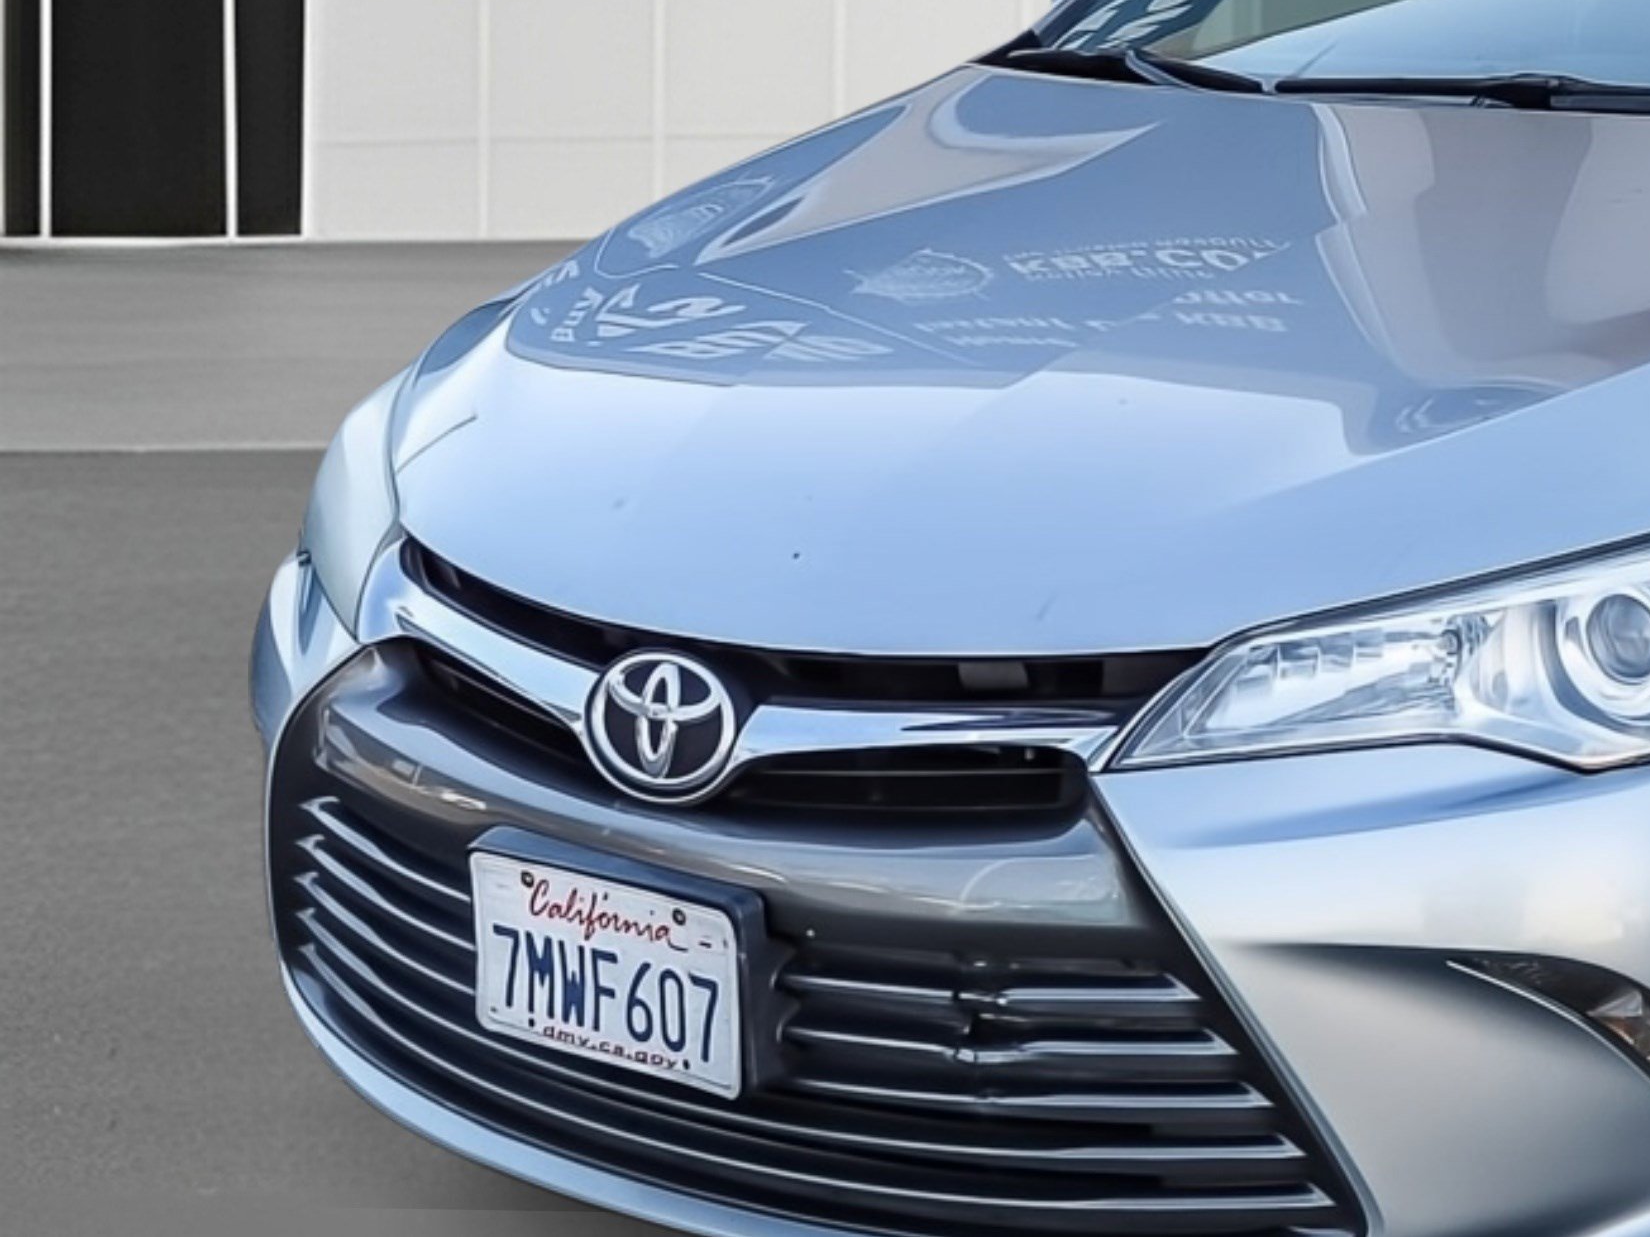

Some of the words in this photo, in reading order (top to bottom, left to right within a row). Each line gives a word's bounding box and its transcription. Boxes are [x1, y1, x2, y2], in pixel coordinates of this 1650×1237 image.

[529, 878, 689, 952] California
[492, 923, 719, 1063] 7MWF607
[542, 1024, 678, 1070] dmv.ca.gov
